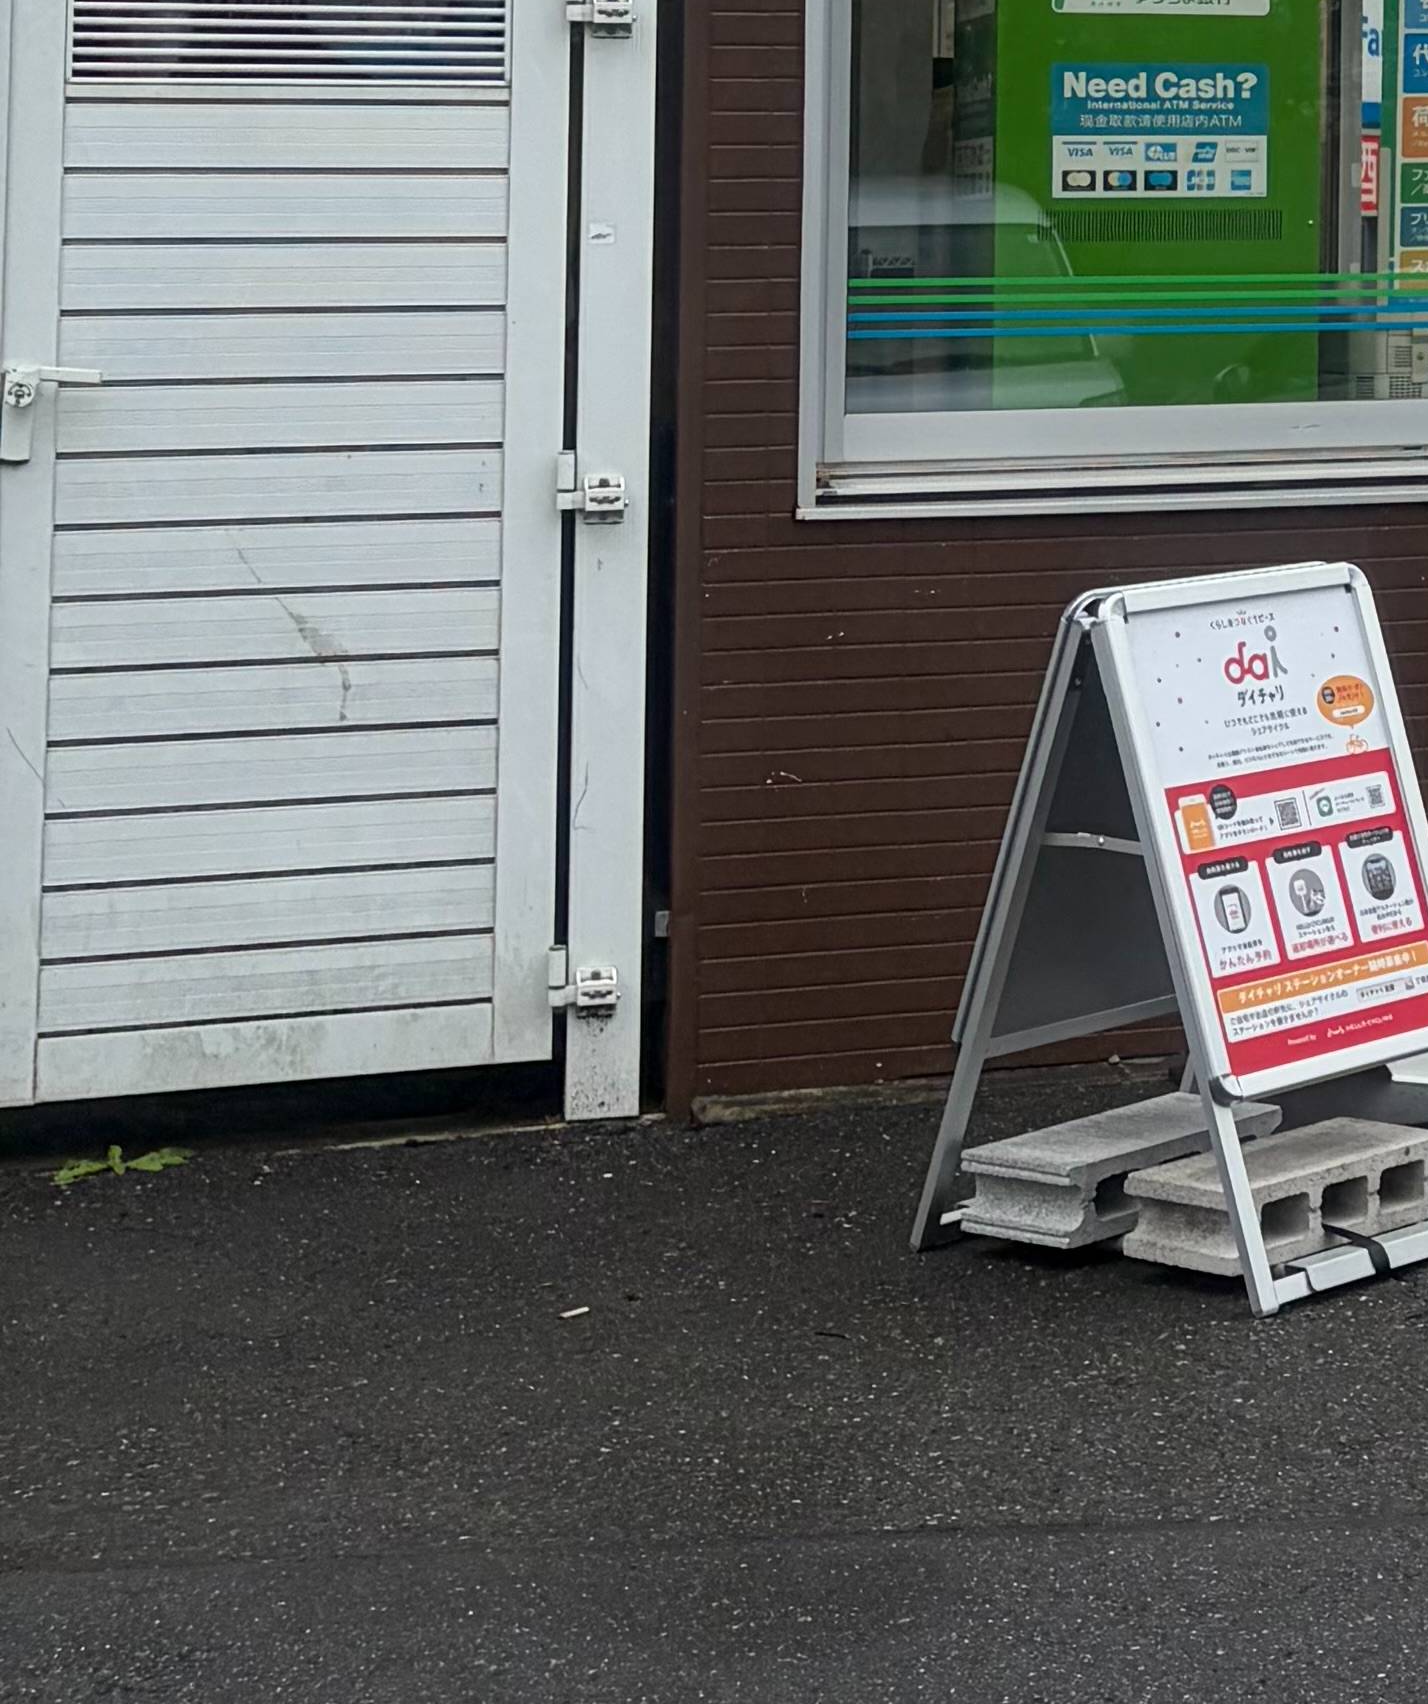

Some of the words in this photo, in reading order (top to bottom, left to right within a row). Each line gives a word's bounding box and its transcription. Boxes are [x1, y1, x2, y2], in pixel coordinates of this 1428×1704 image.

[1063, 71, 1148, 98] Need
[1154, 72, 1258, 99] Cash?
[1087, 100, 1161, 110] International
[1163, 101, 1189, 110] ATM
[1192, 101, 1235, 111] Service
[1067, 147, 1094, 157] VISA
[1108, 146, 1134, 156] VISA
[1237, 685, 1285, 708] ダイチャリ
[1251, 722, 1291, 737] シェアサイクル
